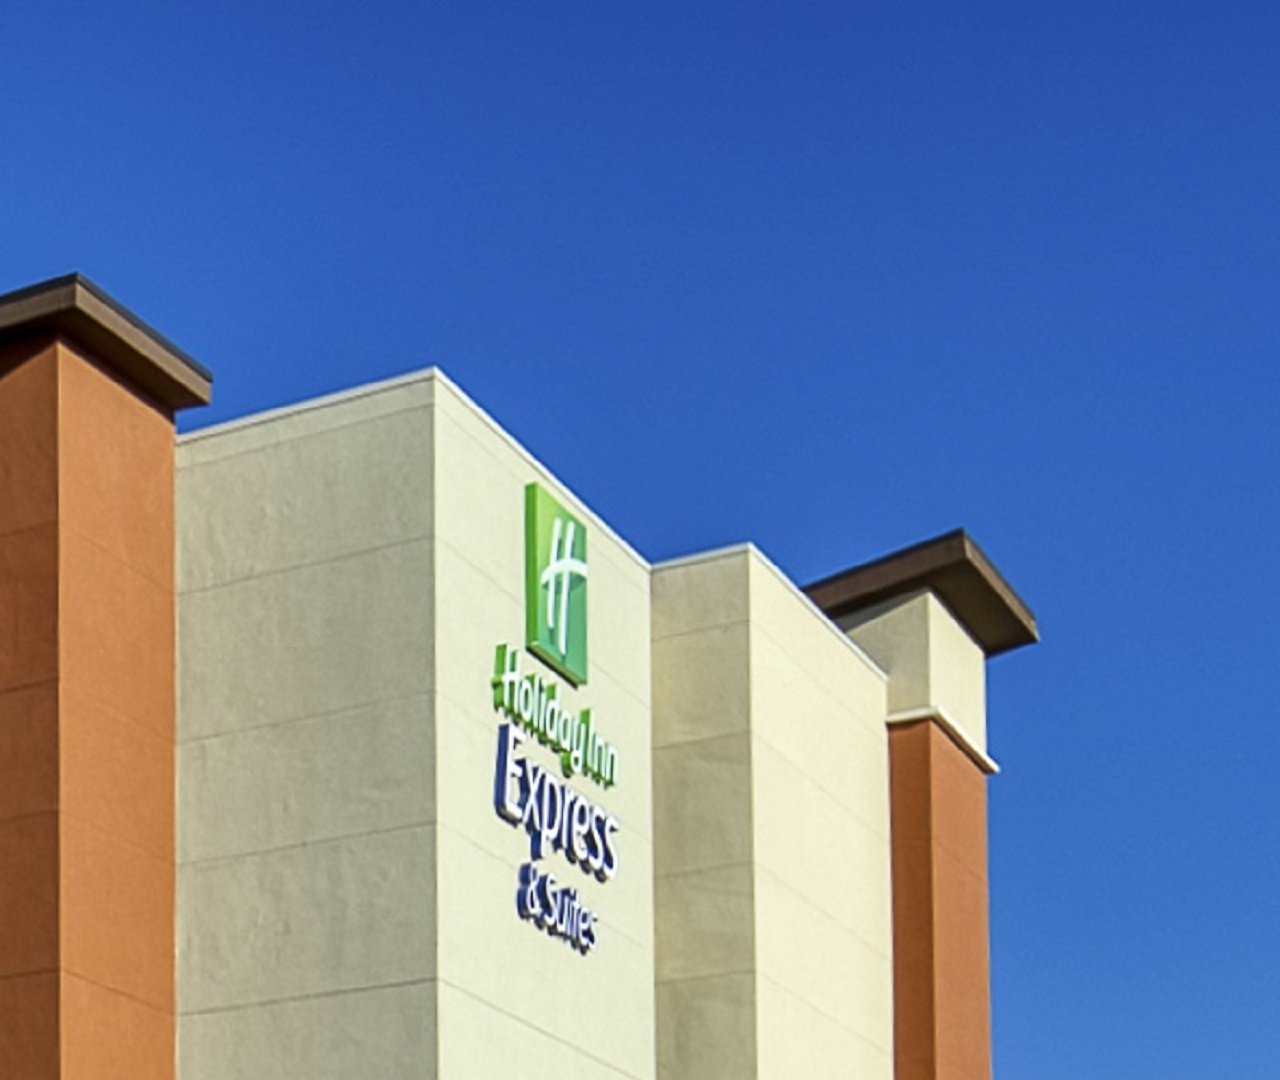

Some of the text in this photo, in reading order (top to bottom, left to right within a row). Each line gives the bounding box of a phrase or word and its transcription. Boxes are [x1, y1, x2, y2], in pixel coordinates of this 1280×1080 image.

[494, 644, 617, 787] Holiday Inn
[497, 722, 620, 882] Express
[518, 862, 598, 953] & Suites
